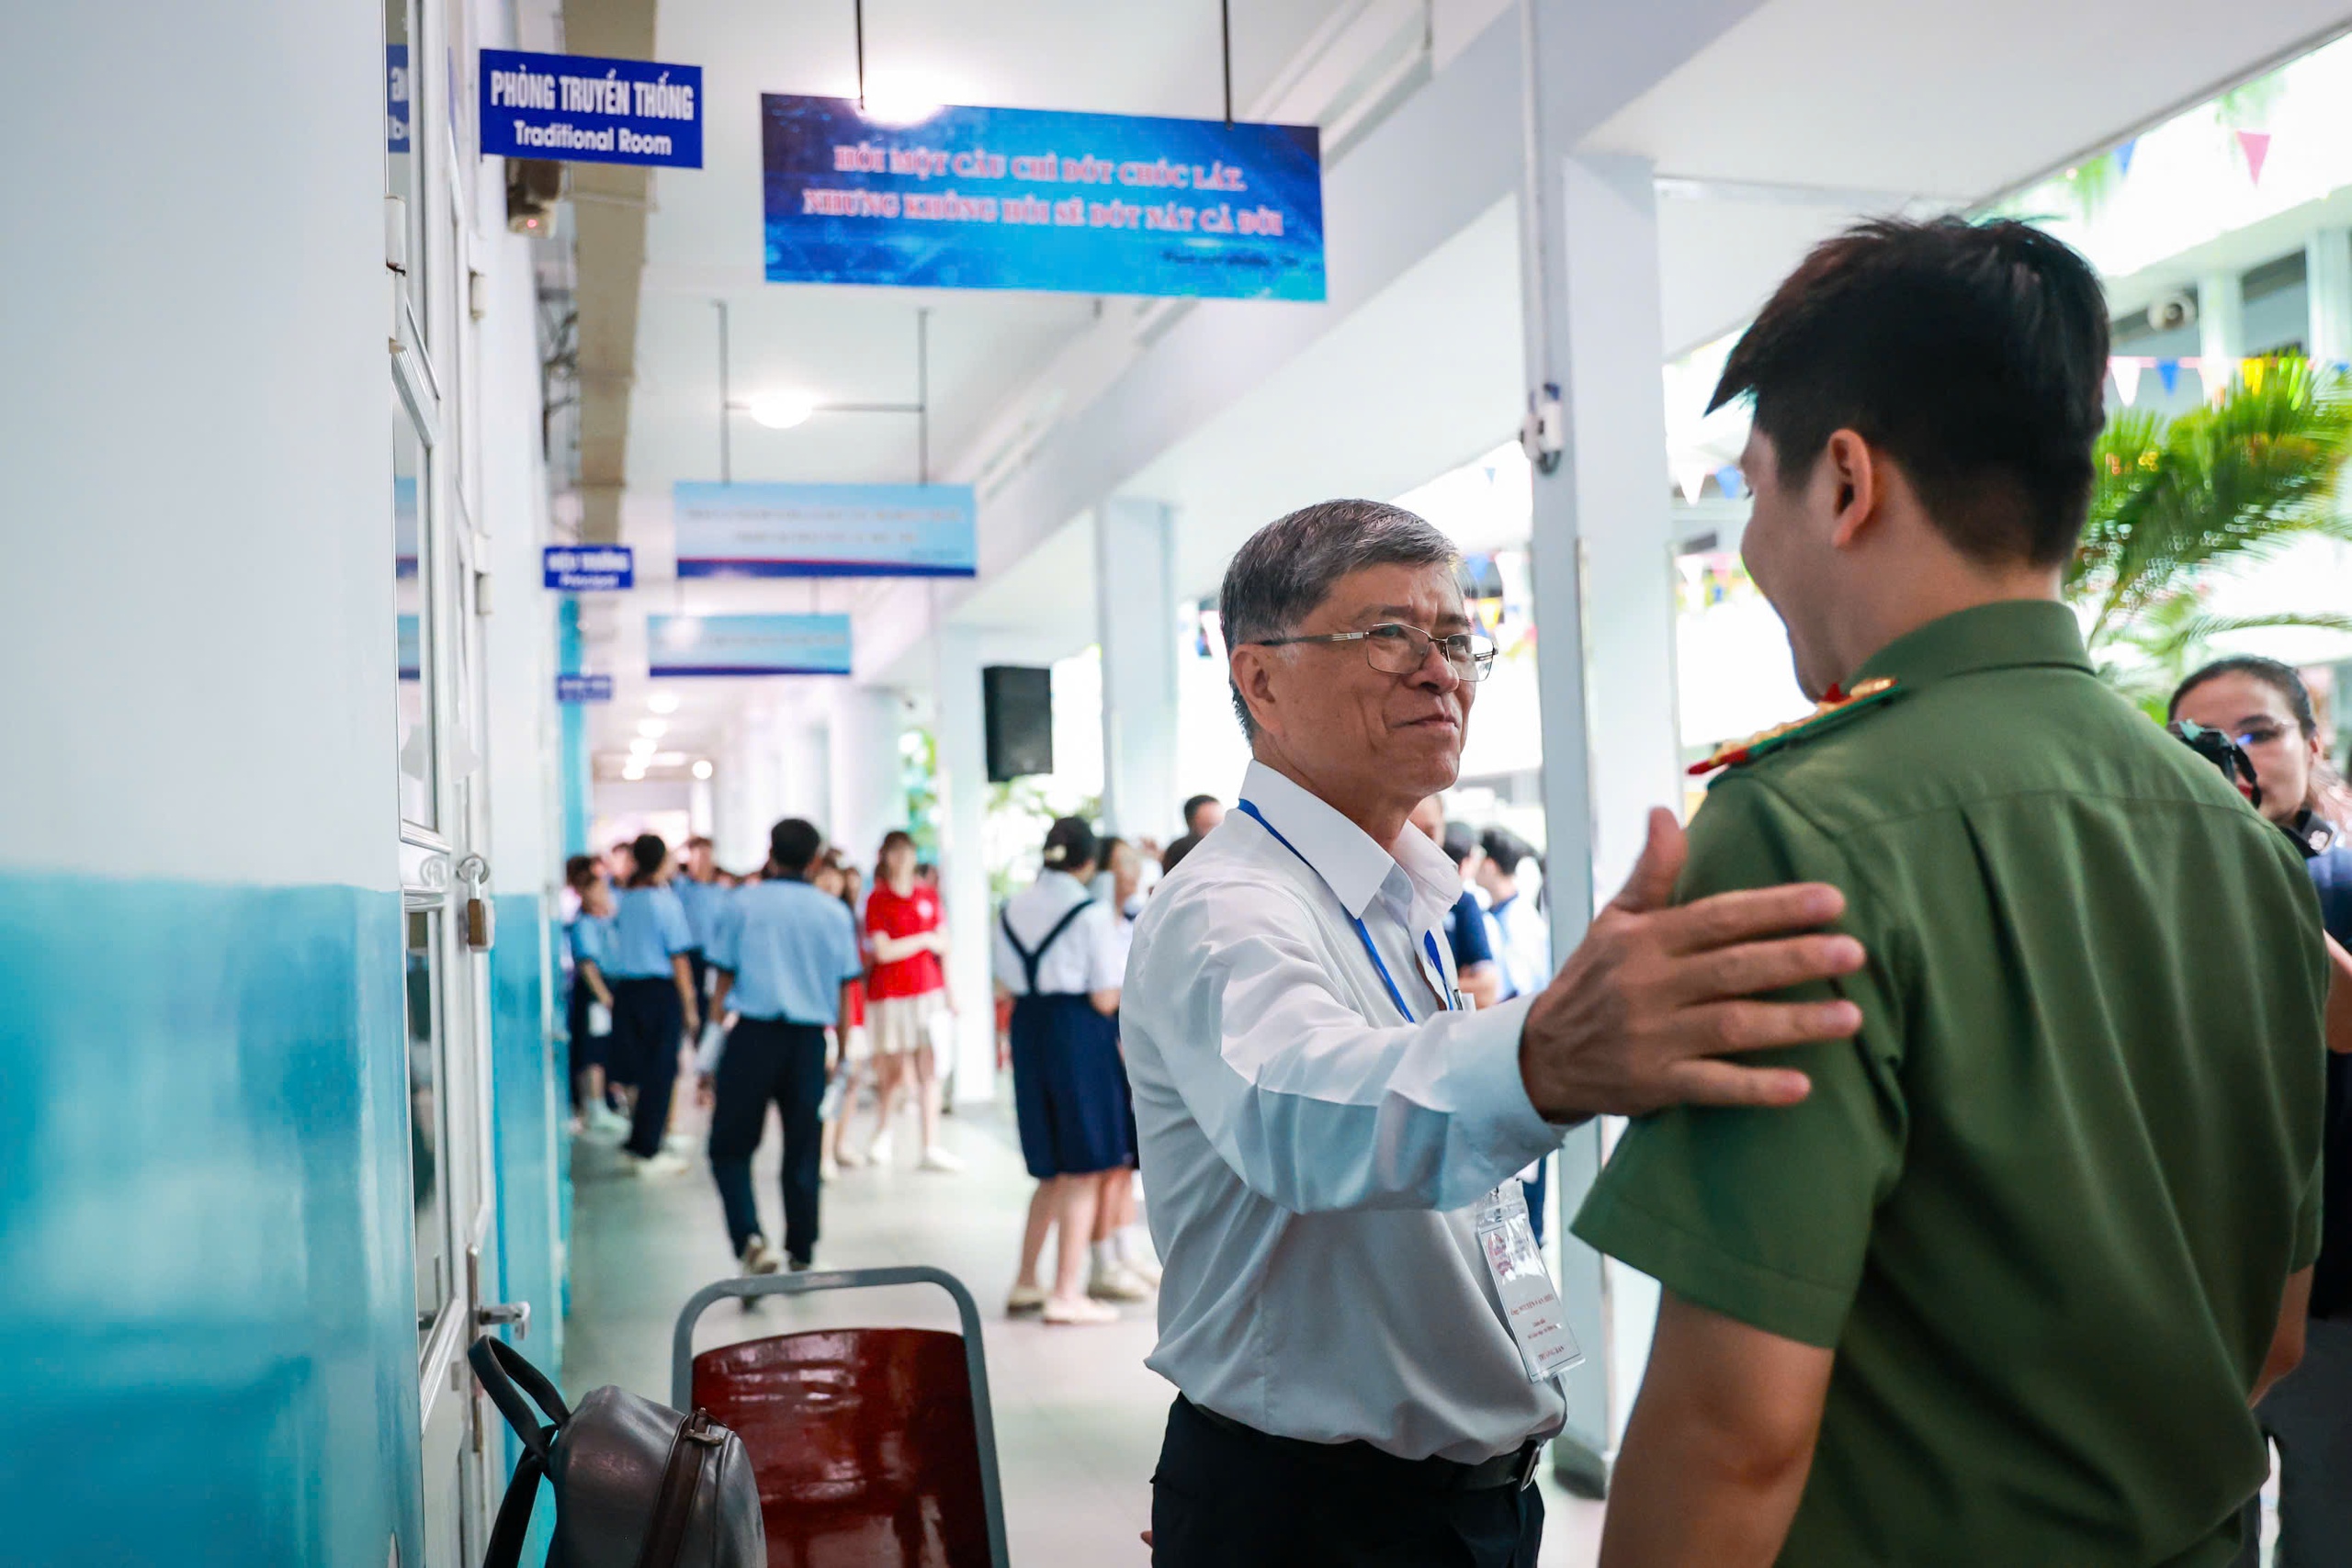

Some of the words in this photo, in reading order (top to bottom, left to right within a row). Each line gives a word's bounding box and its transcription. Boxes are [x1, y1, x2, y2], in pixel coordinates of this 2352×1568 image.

[491, 63, 556, 110] PHÒNG
[633, 71, 694, 120] THỐNG
[514, 119, 614, 151] Traditional
[618, 128, 672, 155] Room
[888, 146, 950, 181] MỘT
[902, 189, 998, 222] KHÔNG
